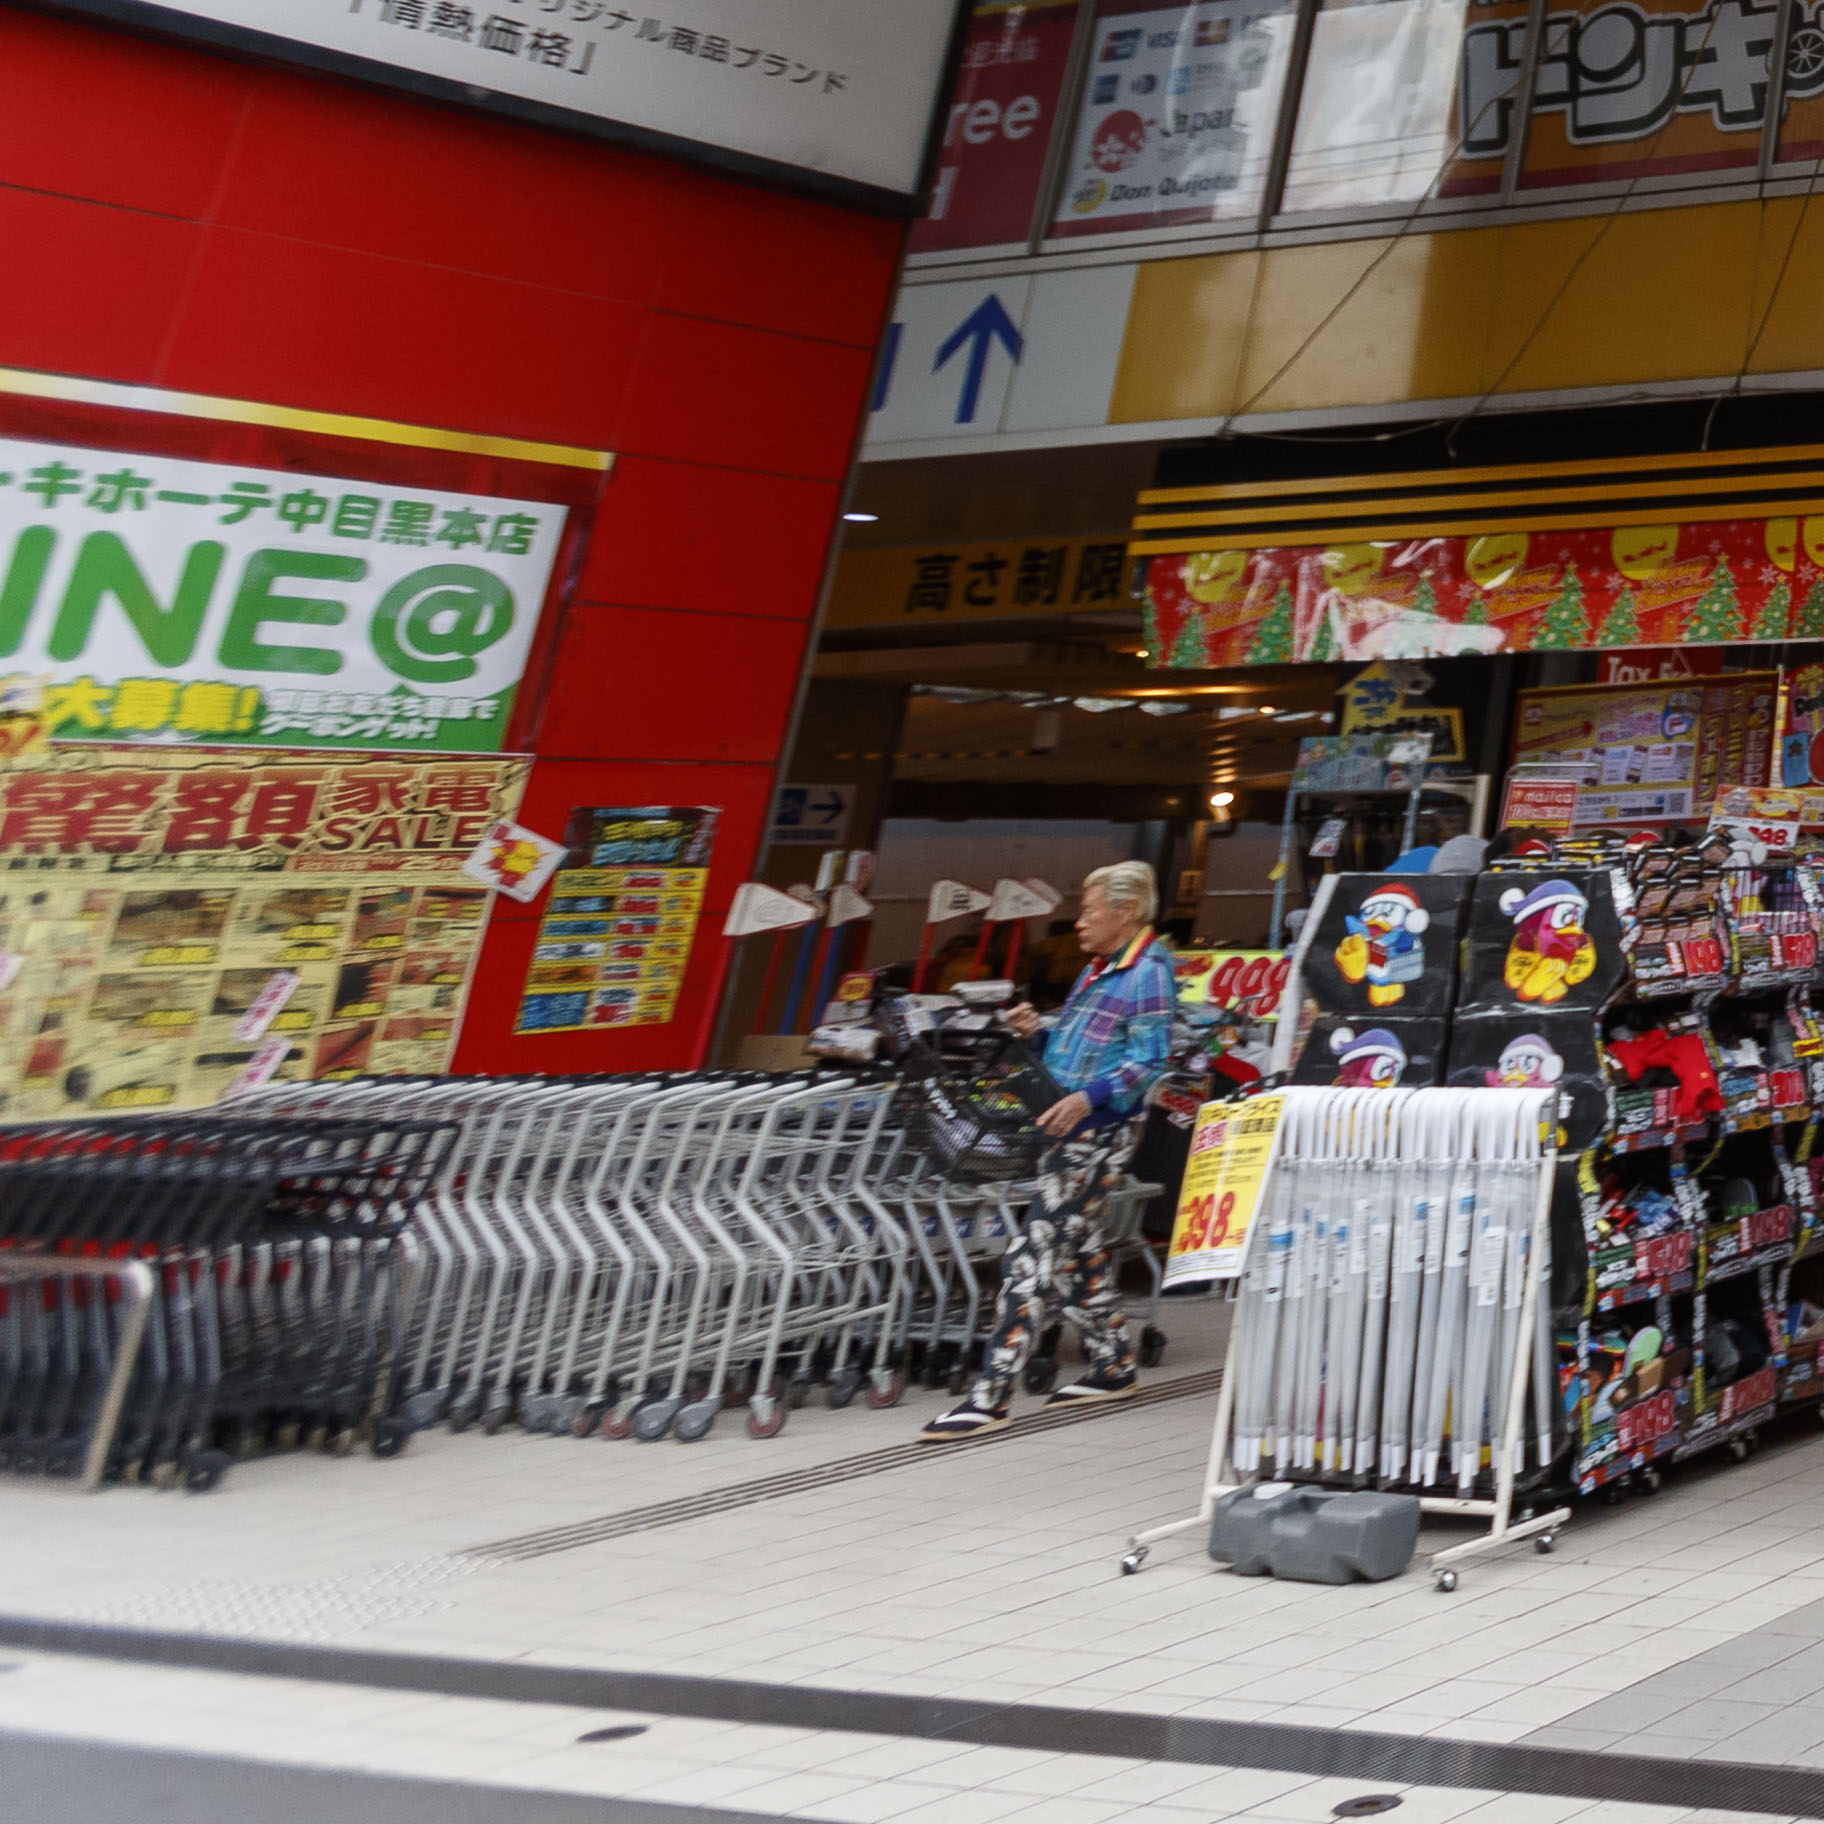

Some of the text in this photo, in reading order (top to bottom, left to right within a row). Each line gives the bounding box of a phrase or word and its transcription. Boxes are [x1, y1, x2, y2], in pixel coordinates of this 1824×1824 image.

[905, 543, 1127, 612] 高さ制限
[321, 818, 486, 851] SALE
